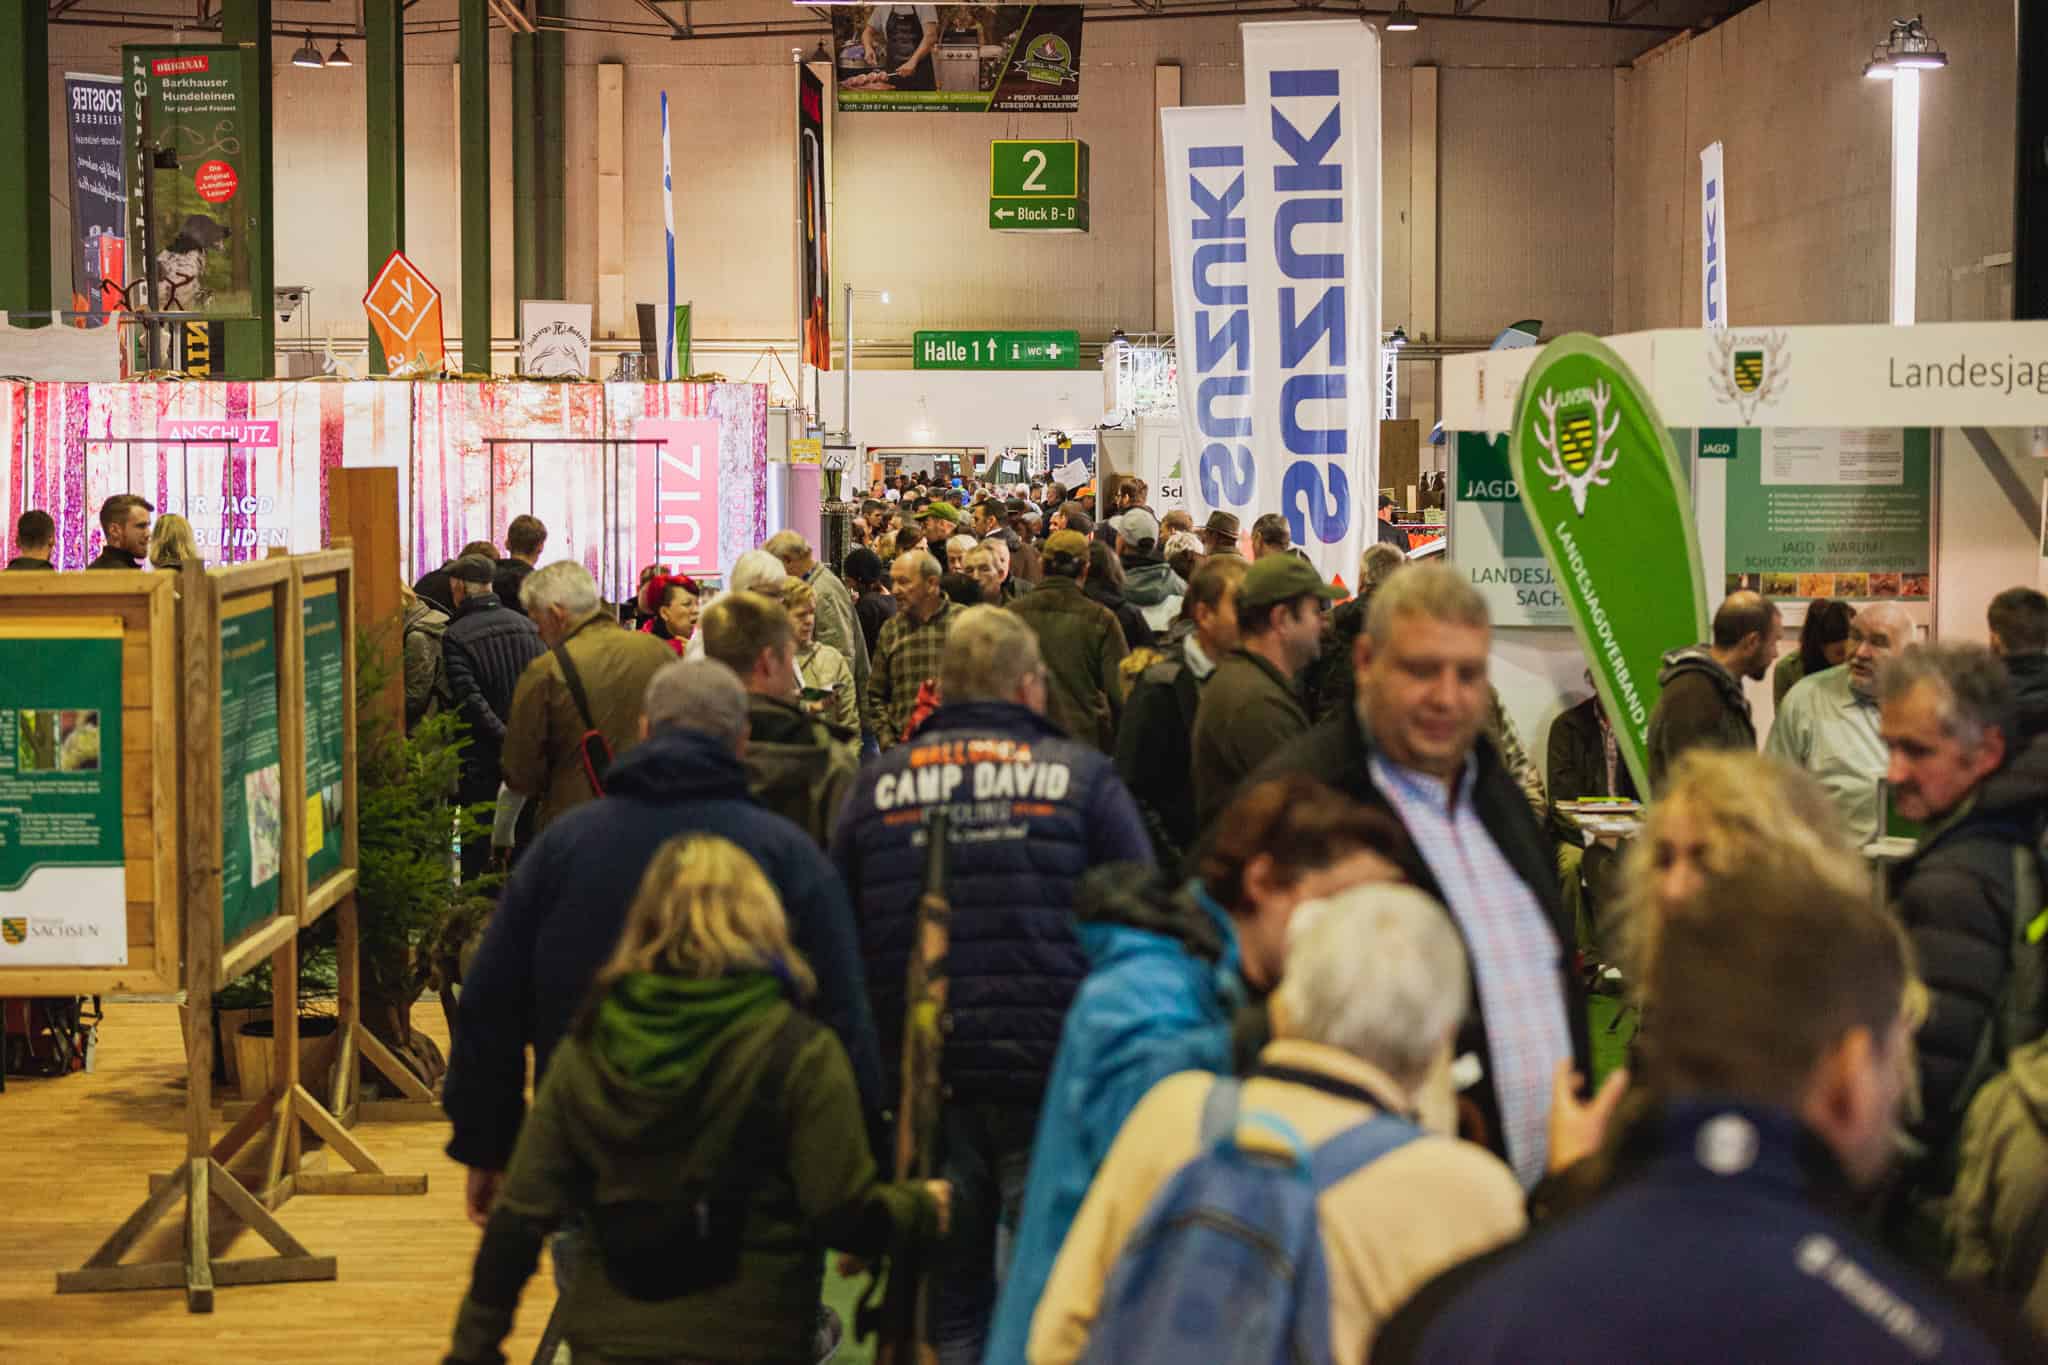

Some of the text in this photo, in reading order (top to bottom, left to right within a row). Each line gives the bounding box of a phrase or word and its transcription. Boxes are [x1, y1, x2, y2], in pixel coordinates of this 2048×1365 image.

[156, 59, 206, 72] ORIGINAL
[162, 78, 229, 88] Barkhauser
[163, 91, 236, 101] Hundeleinen
[1022, 148, 1047, 191] 2
[1018, 206, 1048, 221] Block
[924, 340, 980, 361] Halle 1
[1027, 346, 1042, 356] WC
[1889, 353, 2048, 396] Landesjag
[1703, 444, 1731, 454] JAGD
[1465, 479, 1519, 498] JAGD
[217, 495, 273, 515] JAGD
[1783, 541, 1815, 553] JAGD
[1745, 557, 1788, 567] SCHUTZ
[1556, 520, 1647, 725] LANDESJAGDVERBAND
[875, 761, 1070, 810] CAMP DAVID
[31, 924, 99, 937] SACHSEN
